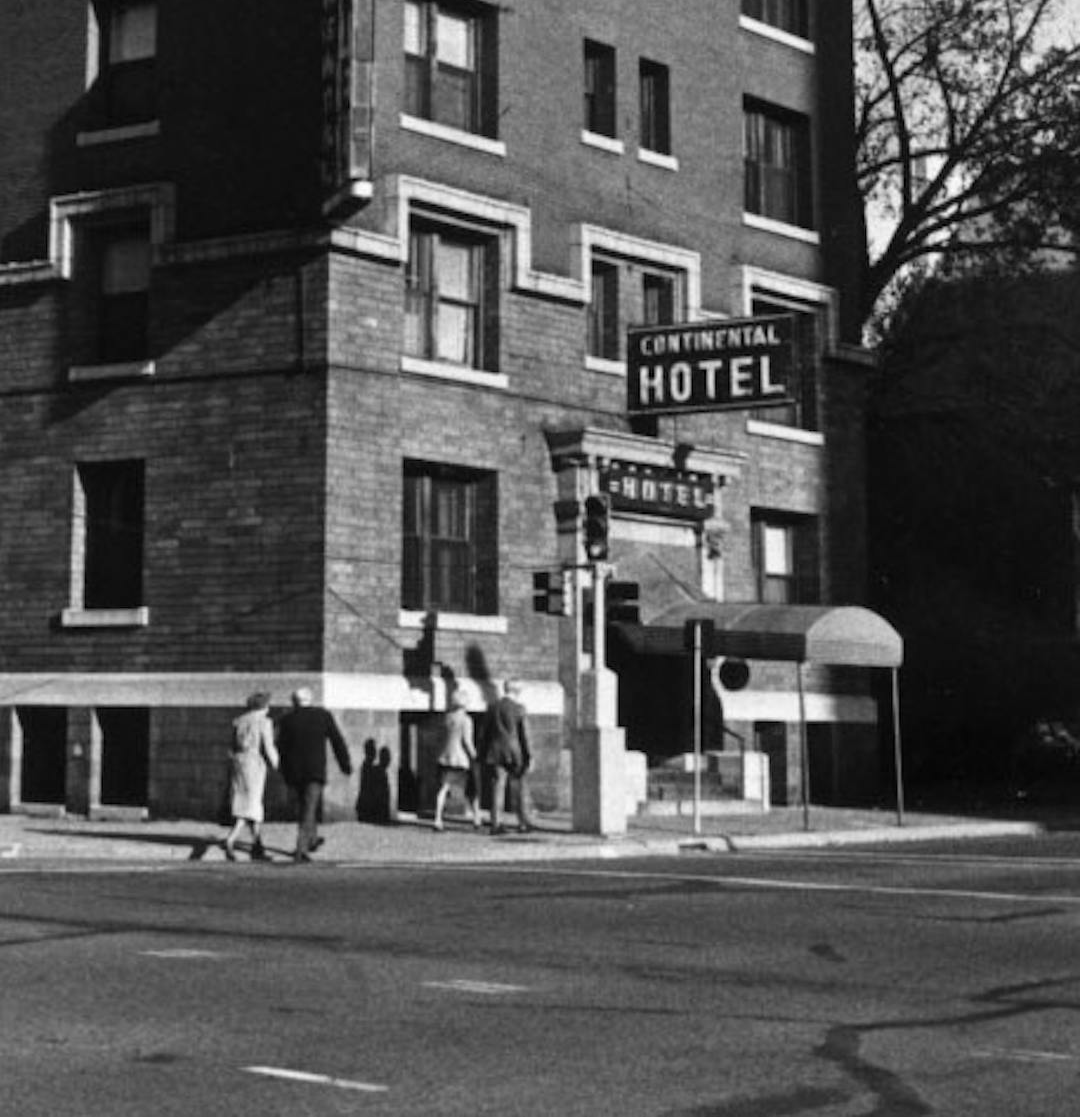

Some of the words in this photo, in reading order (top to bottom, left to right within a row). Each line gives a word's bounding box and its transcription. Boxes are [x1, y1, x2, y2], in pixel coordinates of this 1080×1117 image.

[640, 325, 781, 355] CONTINENTAL
[639, 355, 786, 404] HOTEL
[622, 476, 707, 508] HOTEL
